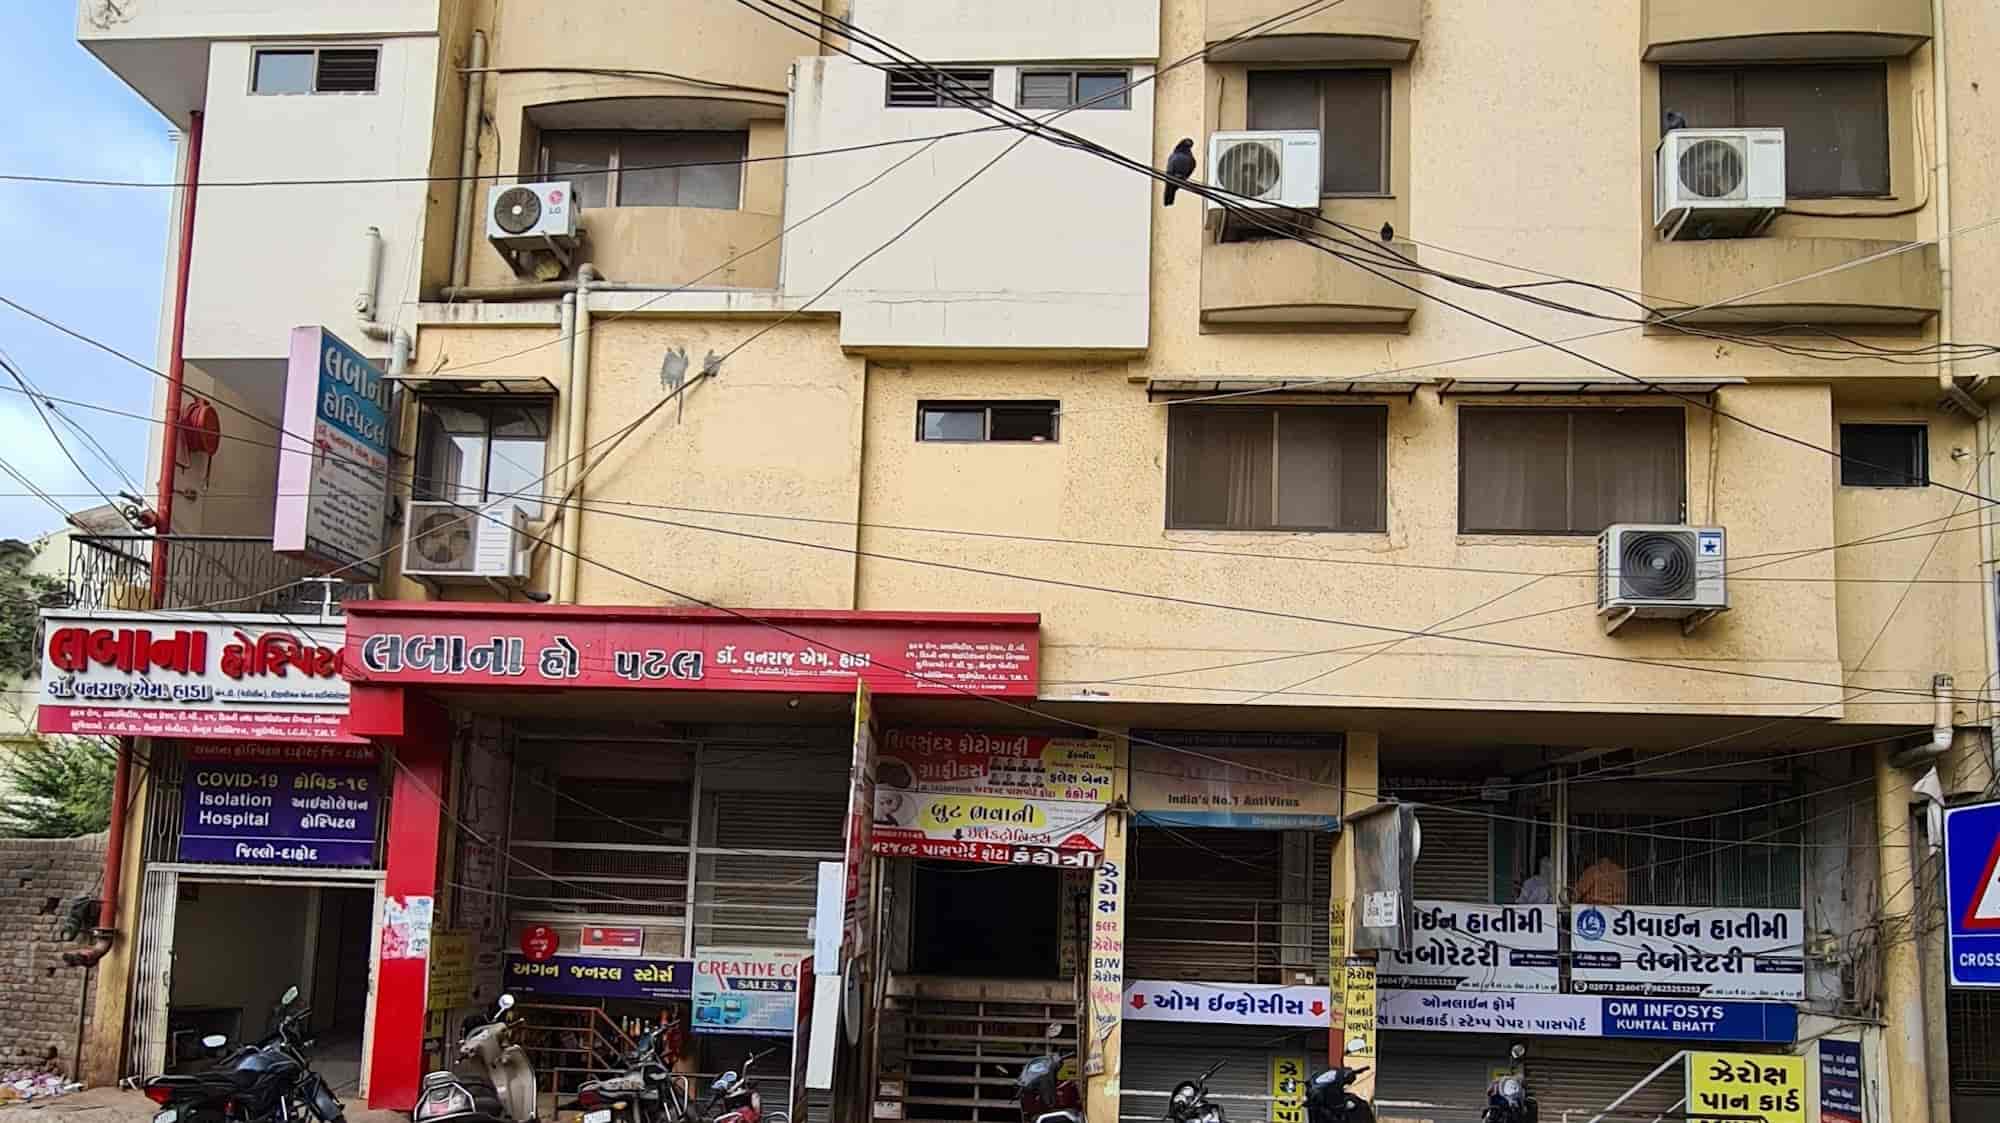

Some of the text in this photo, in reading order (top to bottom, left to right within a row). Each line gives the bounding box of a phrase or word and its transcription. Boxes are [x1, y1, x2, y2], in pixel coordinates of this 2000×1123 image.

[325, 346, 389, 412] લબાના
[50, 628, 207, 675] લબાના
[362, 634, 525, 677] લબાના
[197, 773, 278, 788] COVID-19
[199, 792, 271, 807] Isolation
[199, 810, 269, 828] Hospital
[1466, 907, 1543, 934] હાતીમી
[1710, 912, 1788, 940] હાતીમી
[1095, 958, 1120, 968] B/W
[1637, 944, 1743, 973] લેબોરેટરી
[570, 966, 622, 980] જનરલ
[698, 960, 776, 977] CREATIVE
[737, 981, 793, 991] SALES &
[1609, 1003, 1724, 1019] OM INFOSYS
[1616, 1019, 1716, 1032] KUNTAL BHATT
[1700, 1093, 1748, 1111] પાન
